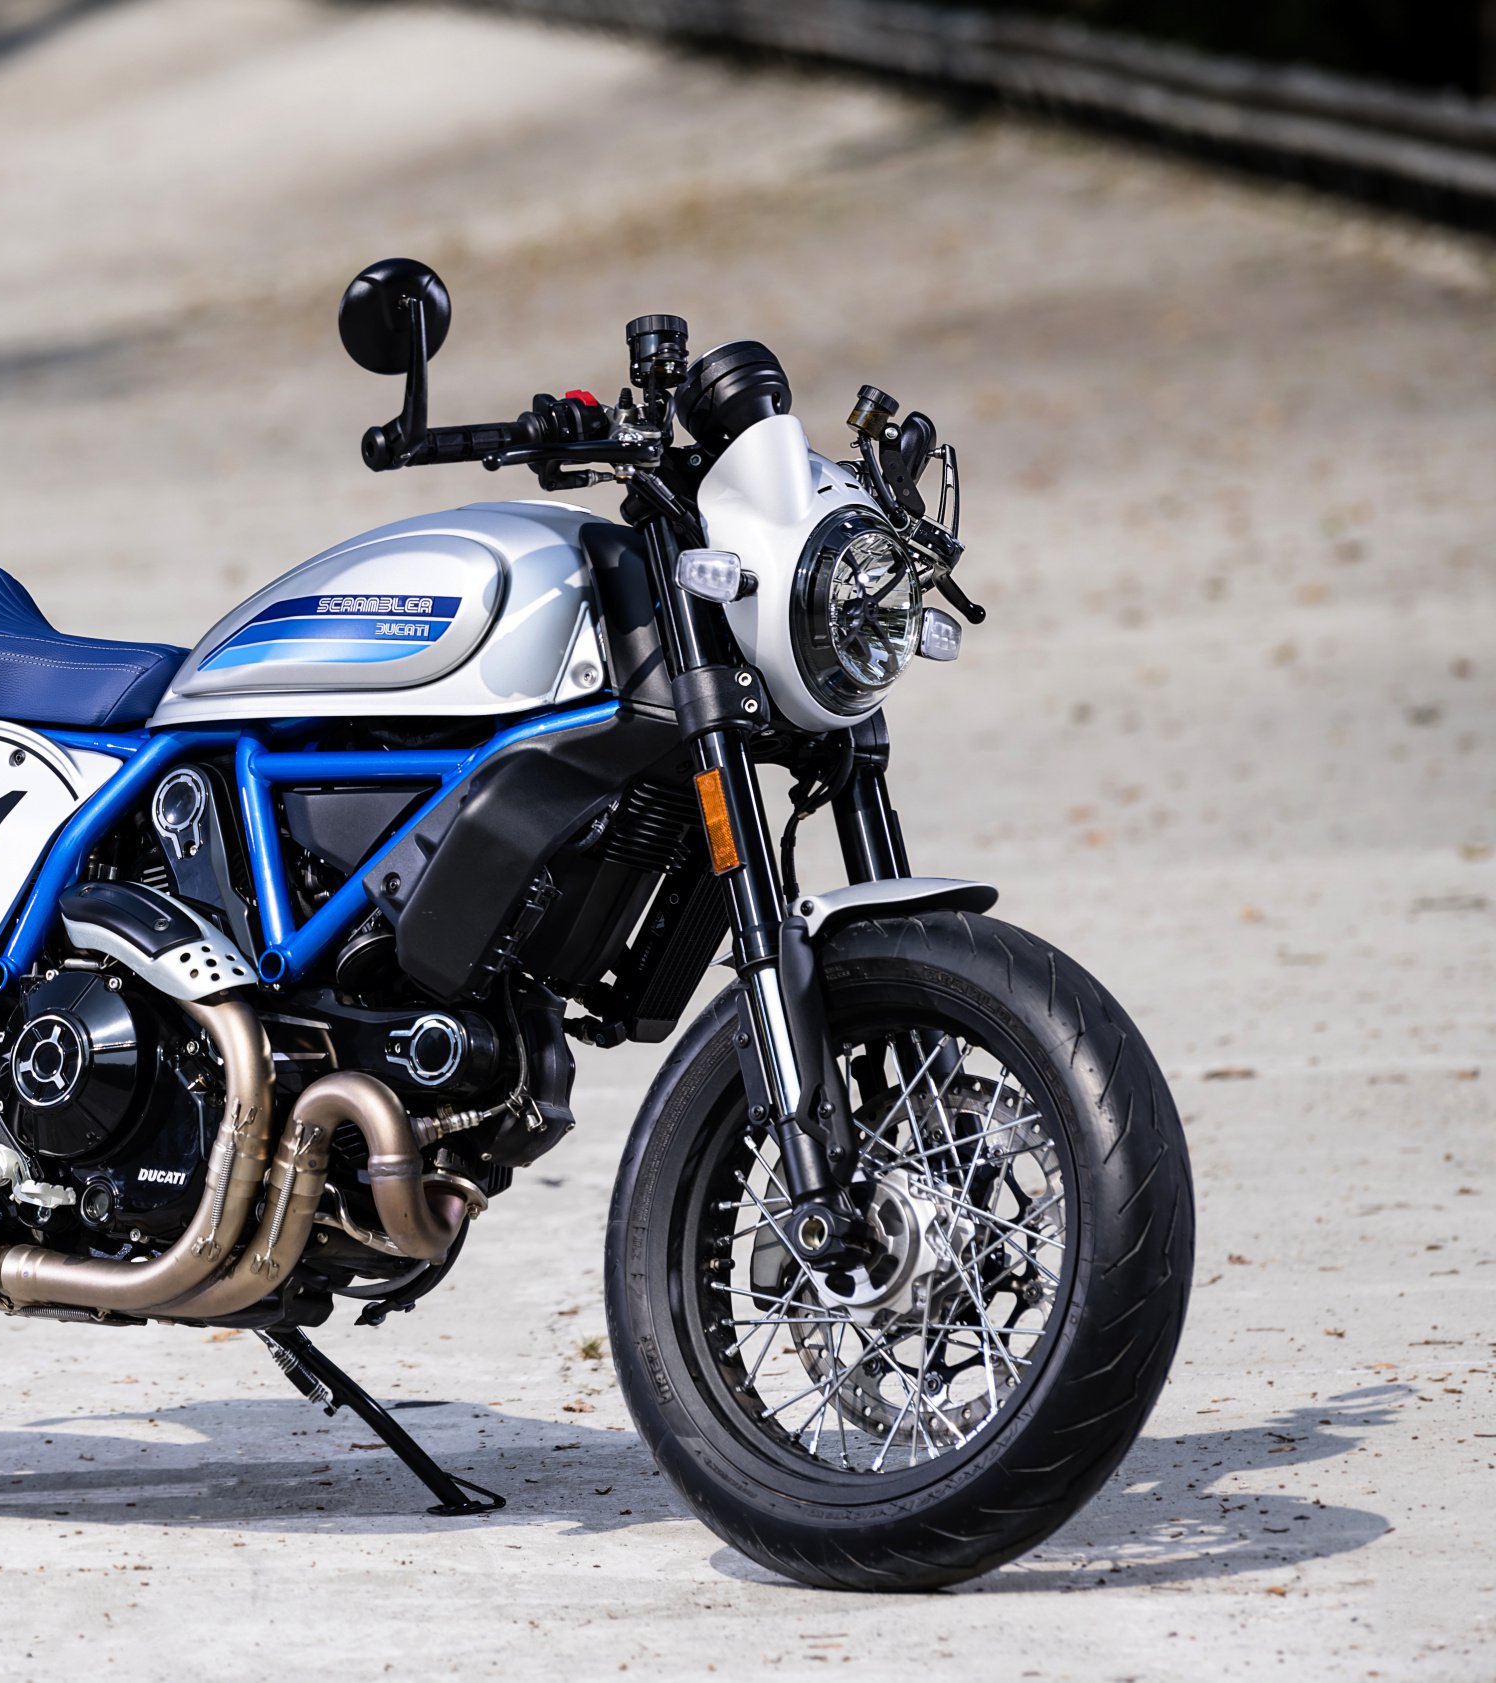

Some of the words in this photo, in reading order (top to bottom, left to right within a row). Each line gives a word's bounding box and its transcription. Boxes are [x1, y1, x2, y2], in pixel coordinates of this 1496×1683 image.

[317, 597, 433, 614] SCRAMBLER
[375, 622, 430, 637] DUCATI
[137, 1168, 186, 1185] DUCATI
